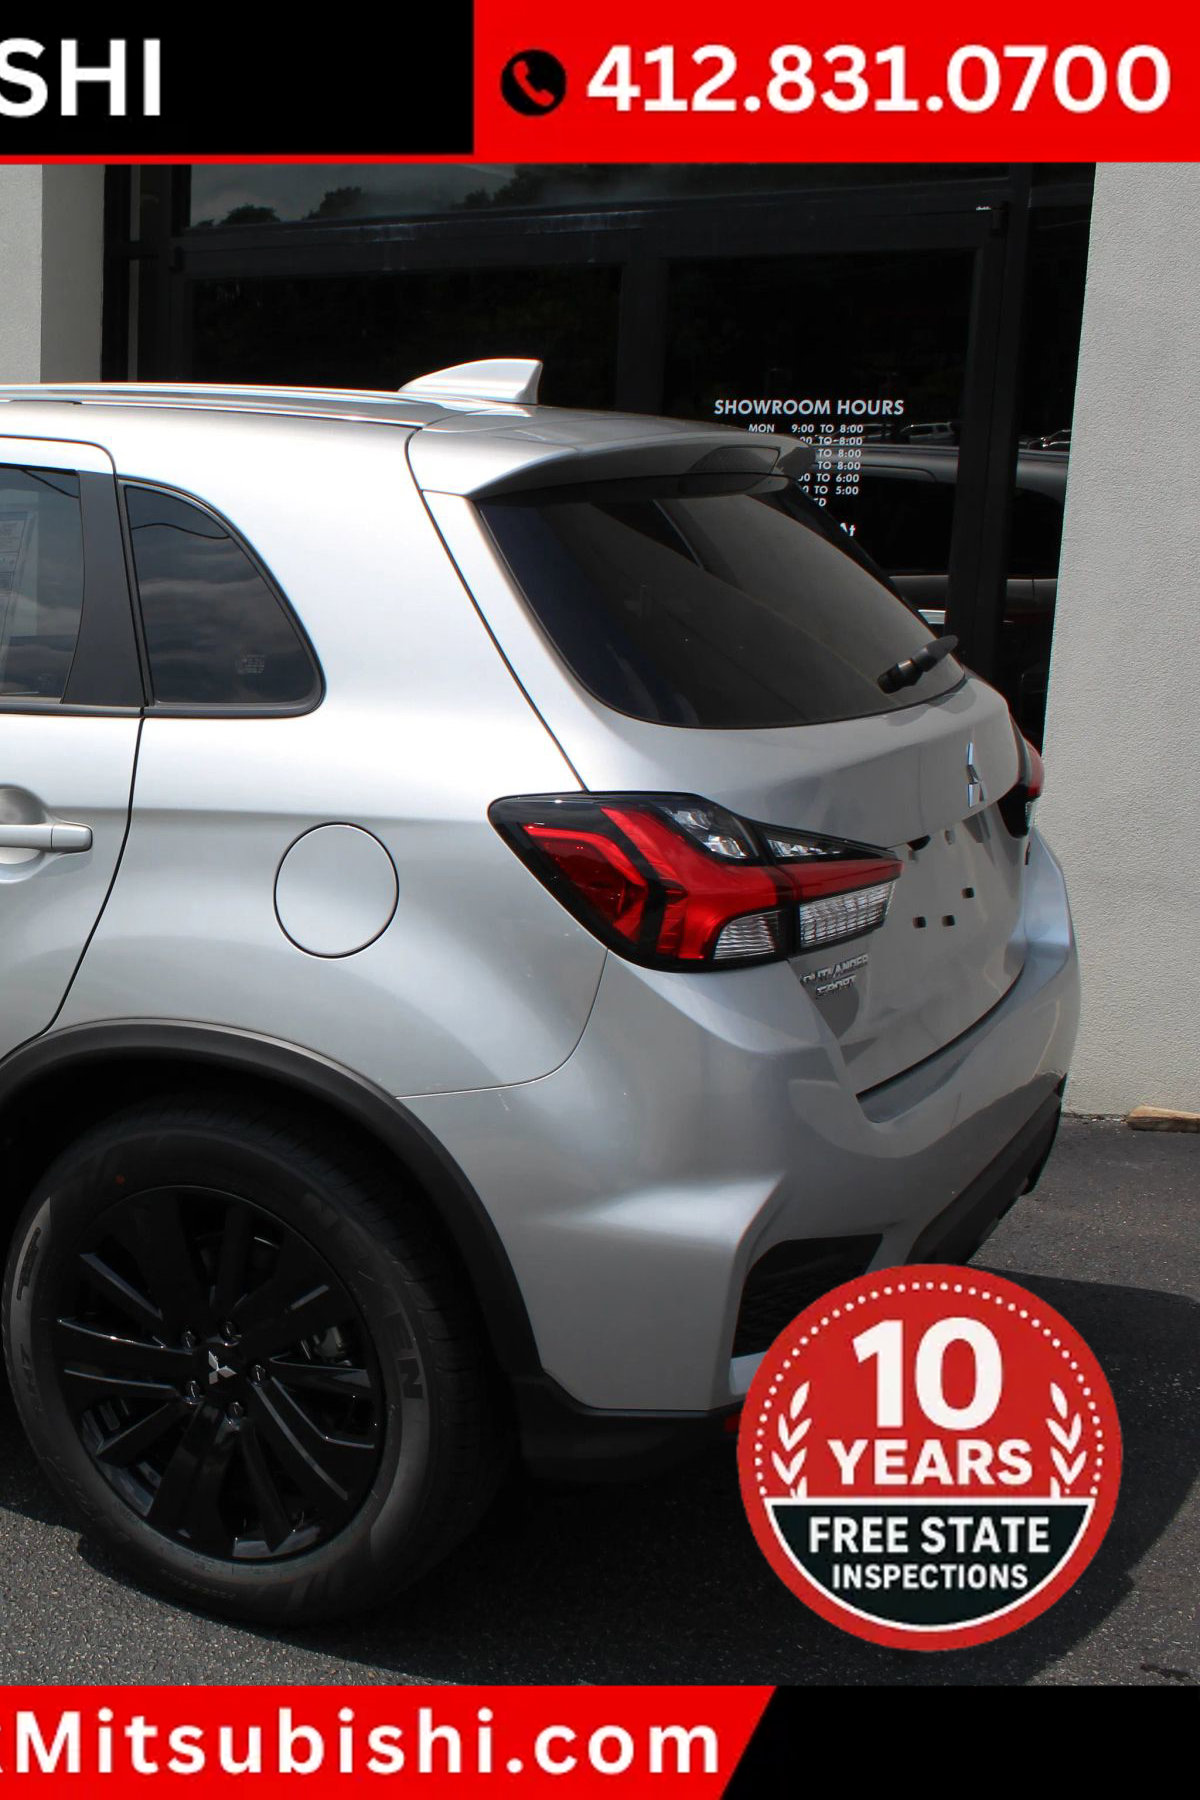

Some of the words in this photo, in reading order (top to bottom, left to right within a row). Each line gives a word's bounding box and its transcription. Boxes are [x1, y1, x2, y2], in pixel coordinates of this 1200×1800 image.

[714, 400, 831, 415] SHOWROOM
[837, 400, 904, 415] HOURS
[749, 424, 775, 434] MON
[791, 424, 815, 433] 9:00
[820, 424, 834, 433] TO
[840, 424, 863, 433] 8:00
[819, 436, 832, 445] TO
[839, 436, 862, 445] 8:00
[818, 449, 832, 458] TO
[838, 449, 861, 458] 8:00
[817, 461, 831, 470] TO
[837, 461, 860, 470] 8:00
[816, 473, 830, 482] TO
[835, 473, 859, 482] 6:00
[814, 485, 828, 494] TO
[835, 485, 859, 494] 5:00
